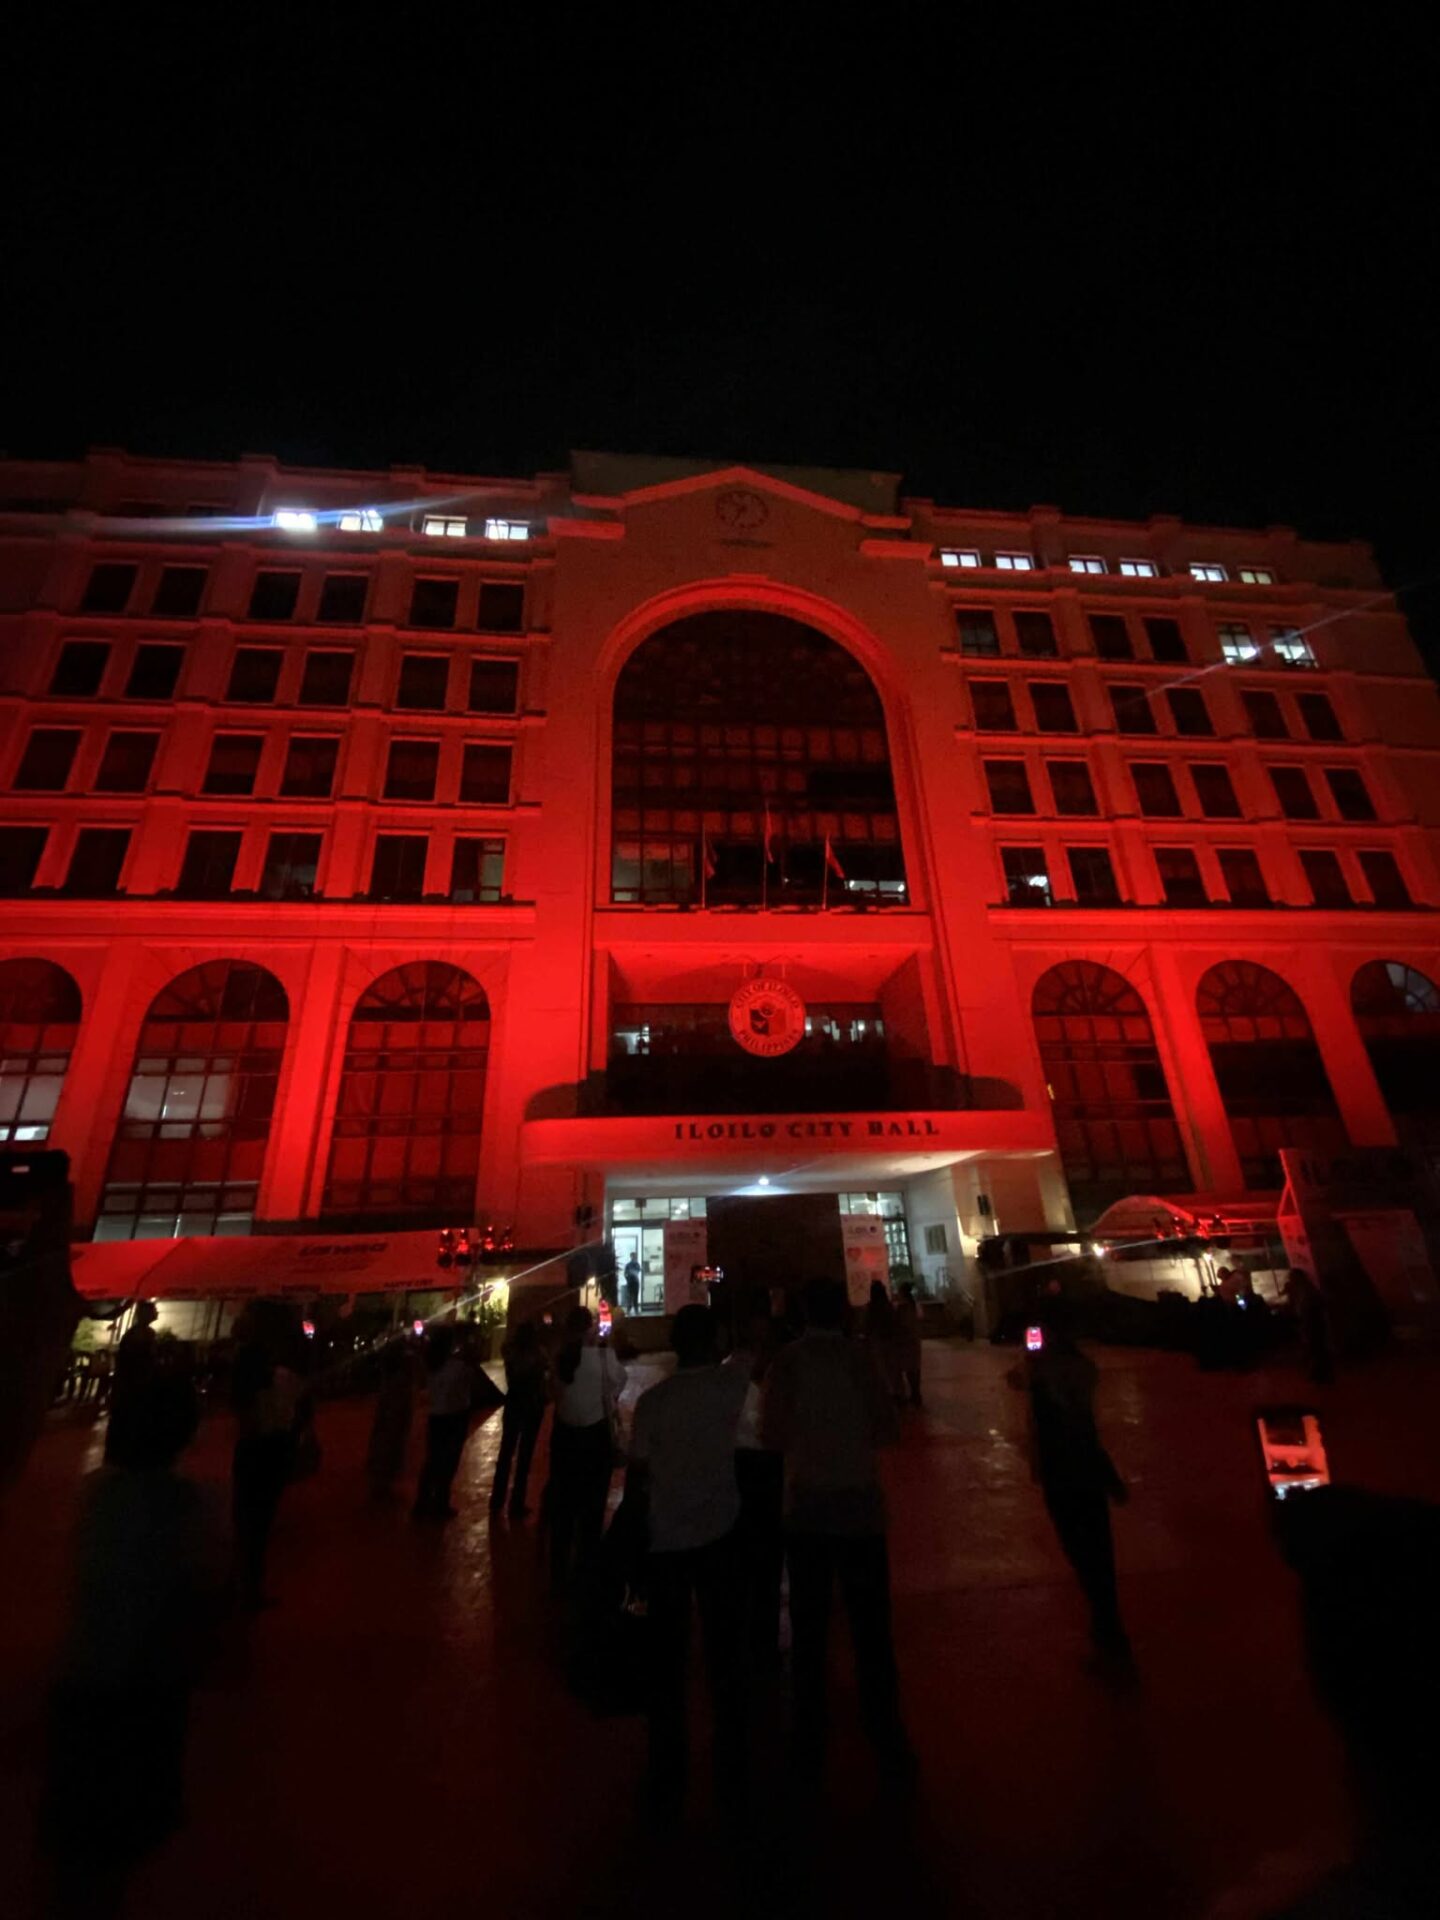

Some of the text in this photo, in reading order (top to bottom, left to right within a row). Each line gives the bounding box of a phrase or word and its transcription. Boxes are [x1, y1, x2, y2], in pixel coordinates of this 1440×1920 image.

[735, 986, 751, 1008] CITY
[674, 1119, 939, 1140] ILOILO CITY HALL
